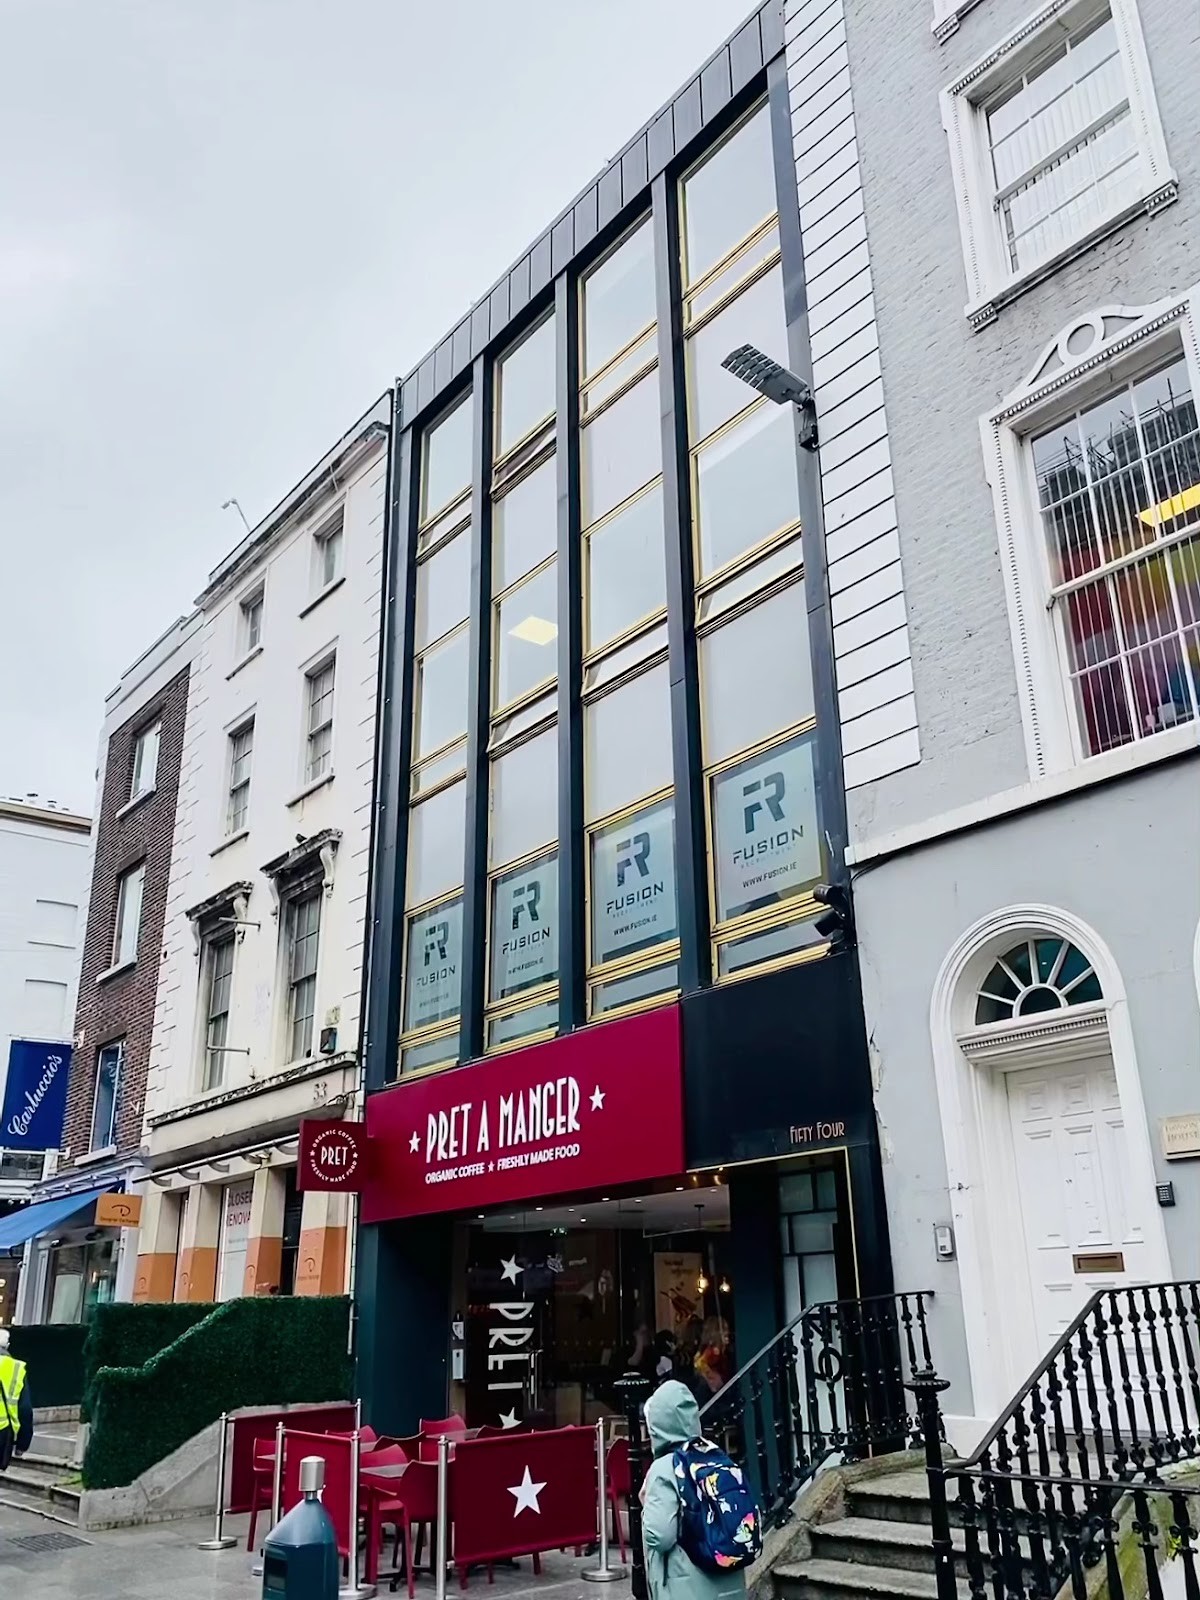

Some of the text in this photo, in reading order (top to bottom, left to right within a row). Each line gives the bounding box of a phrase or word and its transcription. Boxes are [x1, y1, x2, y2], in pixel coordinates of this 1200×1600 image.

[733, 825, 804, 864] FUSION
[606, 882, 664, 914] FUSION
[502, 927, 550, 955] FUSION
[416, 965, 456, 987] FUSION
[7, 1054, 63, 1136] Carluccio's
[425, 1076, 581, 1164] PRET A MANGER
[816, 1121, 845, 1140] FOUR
[312, 1129, 357, 1150] ORGANIC COFFEE
[320, 1145, 349, 1166] PRET
[425, 1143, 581, 1185] ORGANIC COFFEE FRESHLY MADE FOOD
[310, 1159, 358, 1183] FRESHLY MADE FOOD
